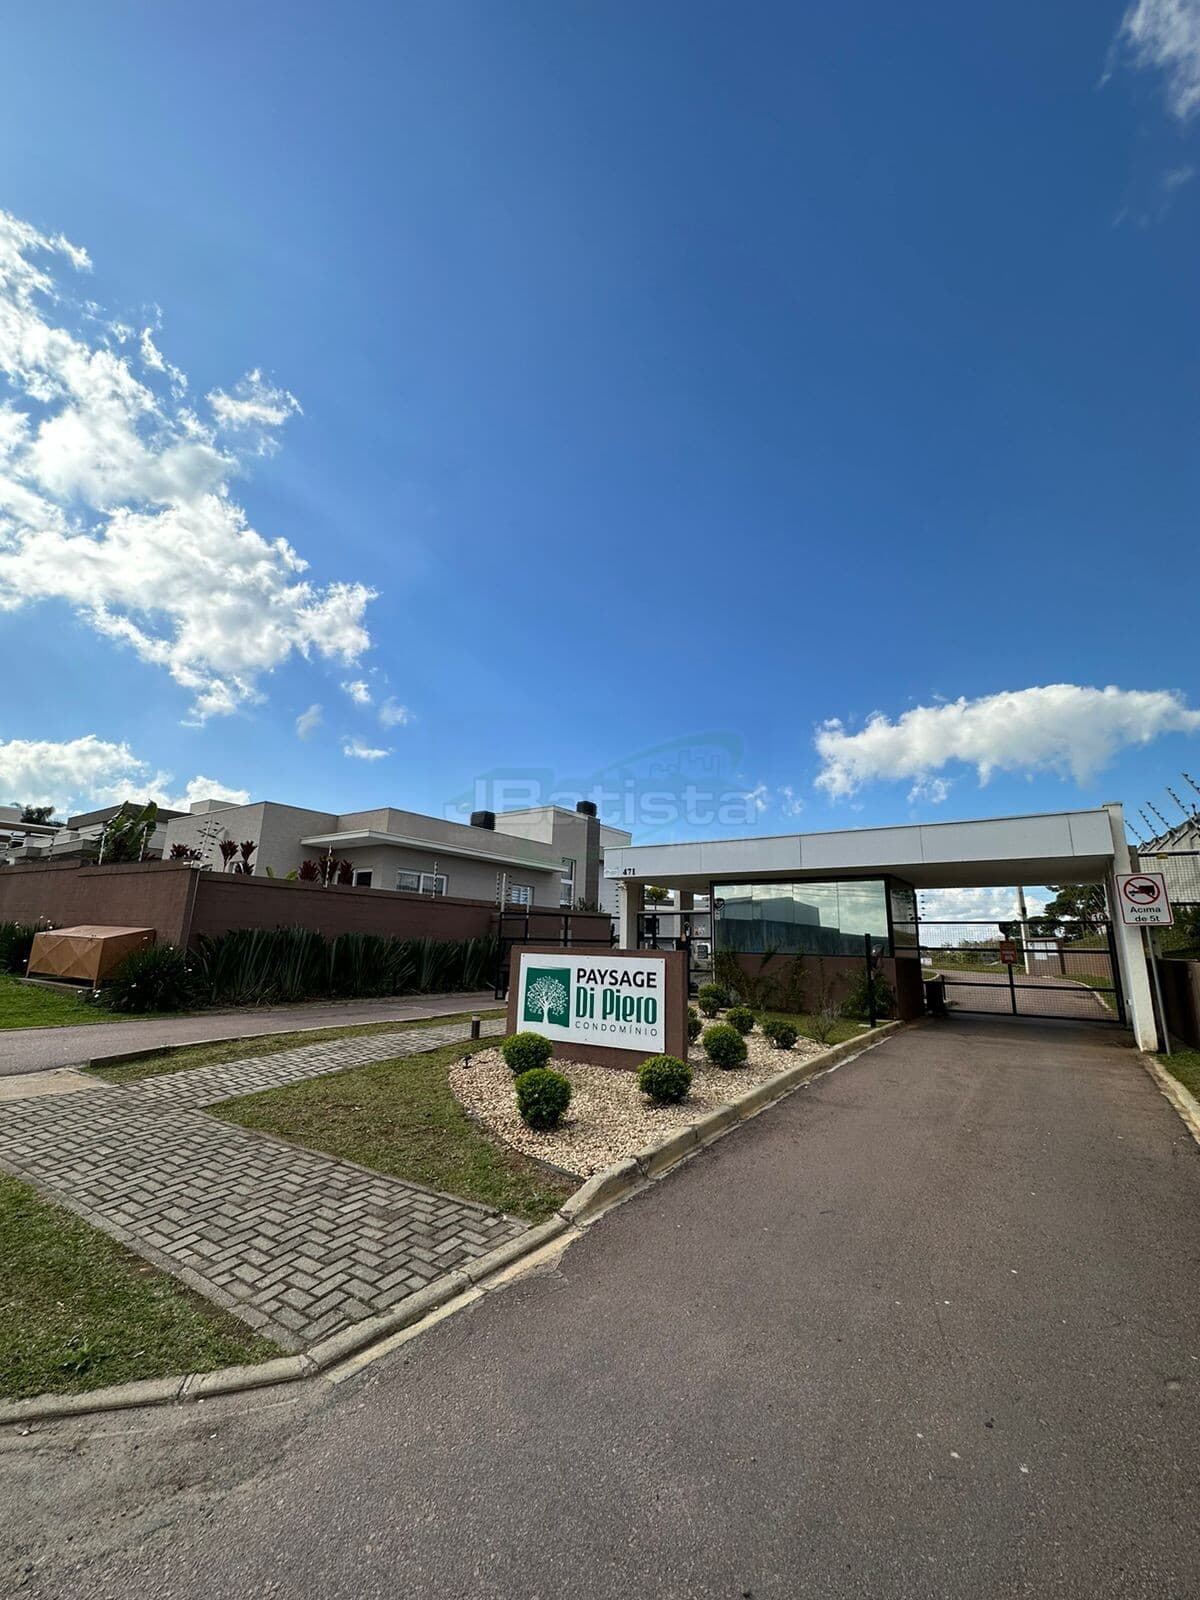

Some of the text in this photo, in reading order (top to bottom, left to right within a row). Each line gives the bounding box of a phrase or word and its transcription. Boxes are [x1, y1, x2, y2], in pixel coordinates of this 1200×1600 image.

[622, 867, 636, 876] 471
[576, 968, 657, 988] PAYSAGE
[575, 986, 657, 1025] Di Piero
[575, 1020, 658, 1037] CONDOMÍNIO
